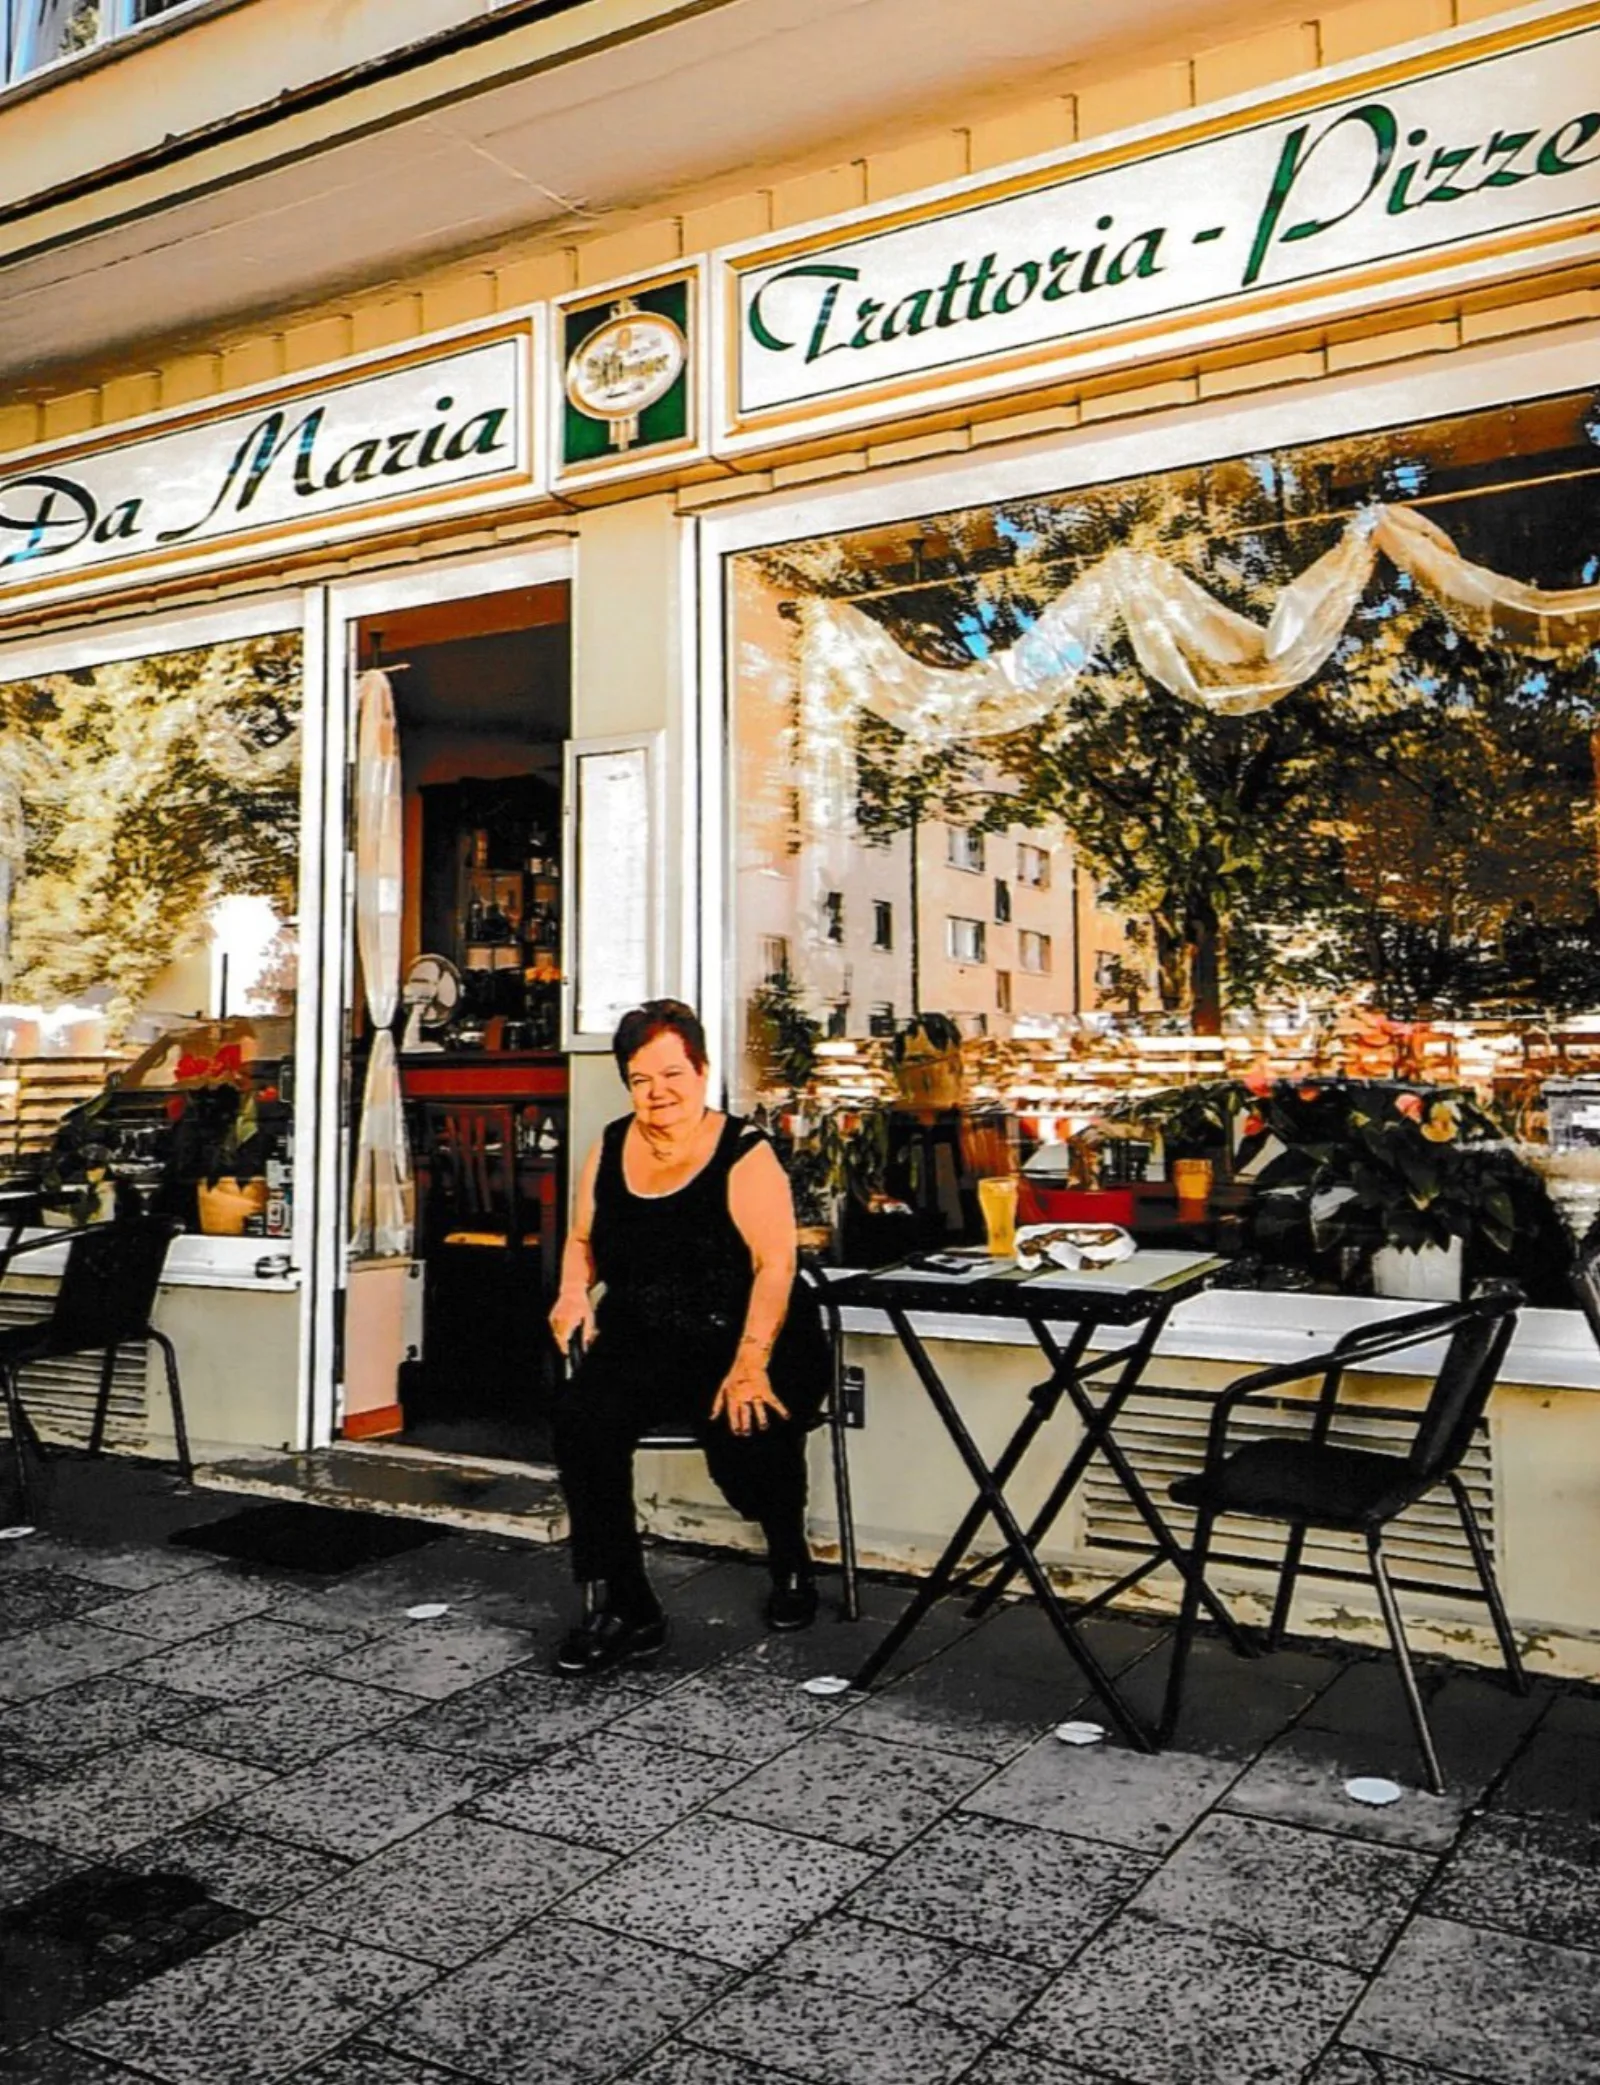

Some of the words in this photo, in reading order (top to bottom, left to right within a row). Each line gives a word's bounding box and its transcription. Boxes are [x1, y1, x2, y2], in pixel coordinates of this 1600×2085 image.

[748, 214, 1167, 364] Trattoria
[0, 475, 142, 566] Da
[156, 396, 510, 542] Maria
